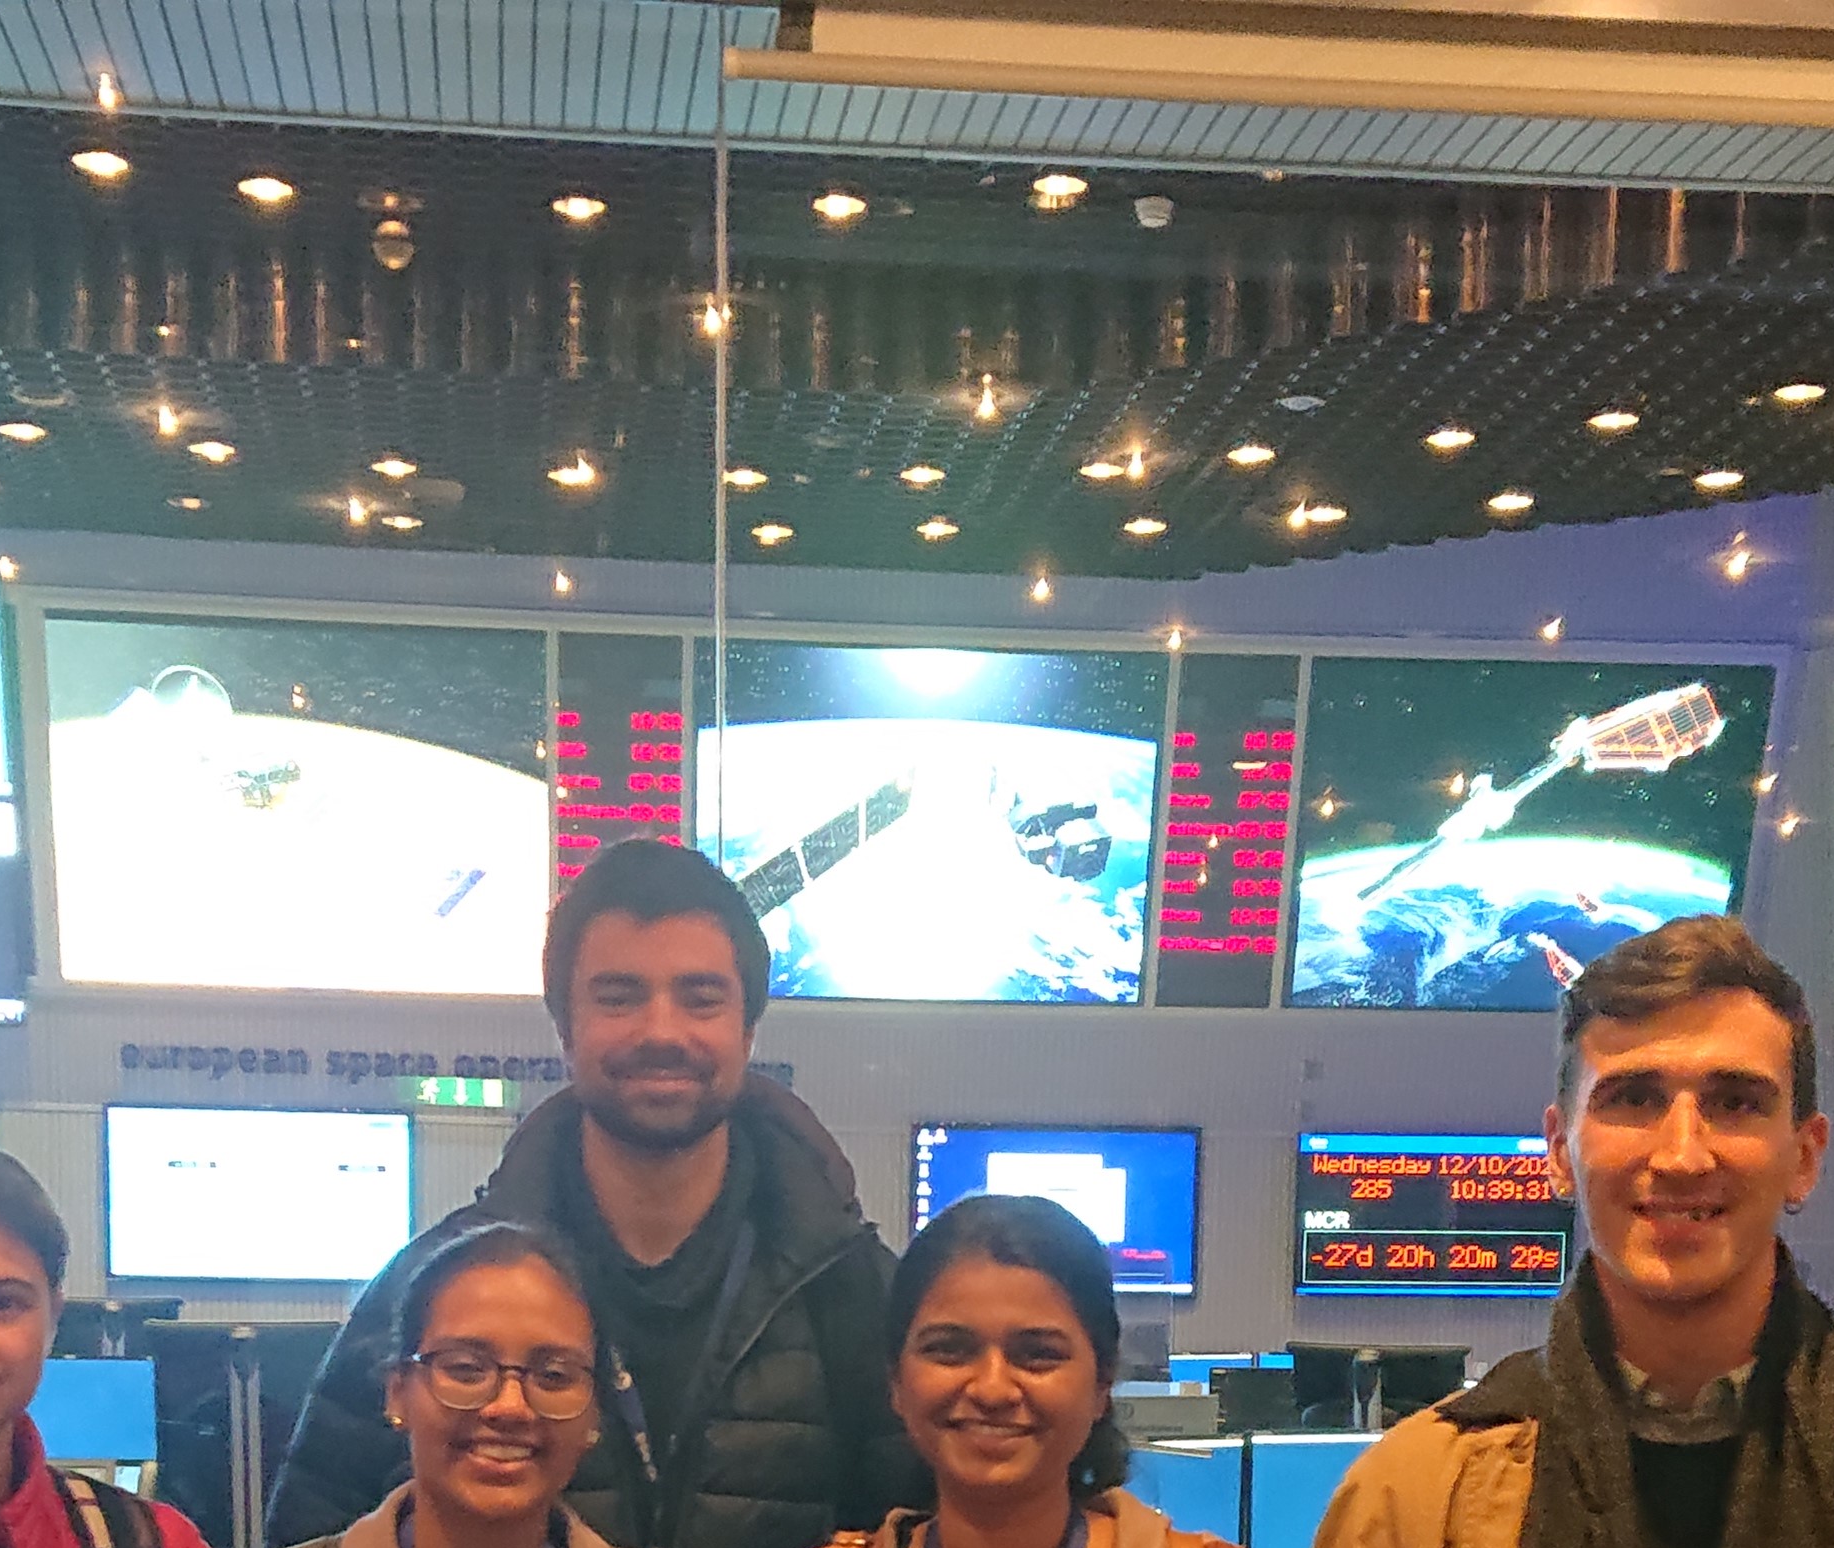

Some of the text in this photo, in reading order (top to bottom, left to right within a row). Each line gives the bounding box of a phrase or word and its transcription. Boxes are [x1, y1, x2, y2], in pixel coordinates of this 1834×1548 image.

[120, 1043, 566, 1085] european space opera
[1312, 1154, 1554, 1176] Wednesday 12/10/202
[1351, 1178, 1552, 1200] 285 10:39:31
[1304, 1211, 1351, 1229] MCR
[1311, 1244, 1373, 1267] -27d
[1386, 1244, 1435, 1268] 20h
[1448, 1245, 1497, 1269] 20m
